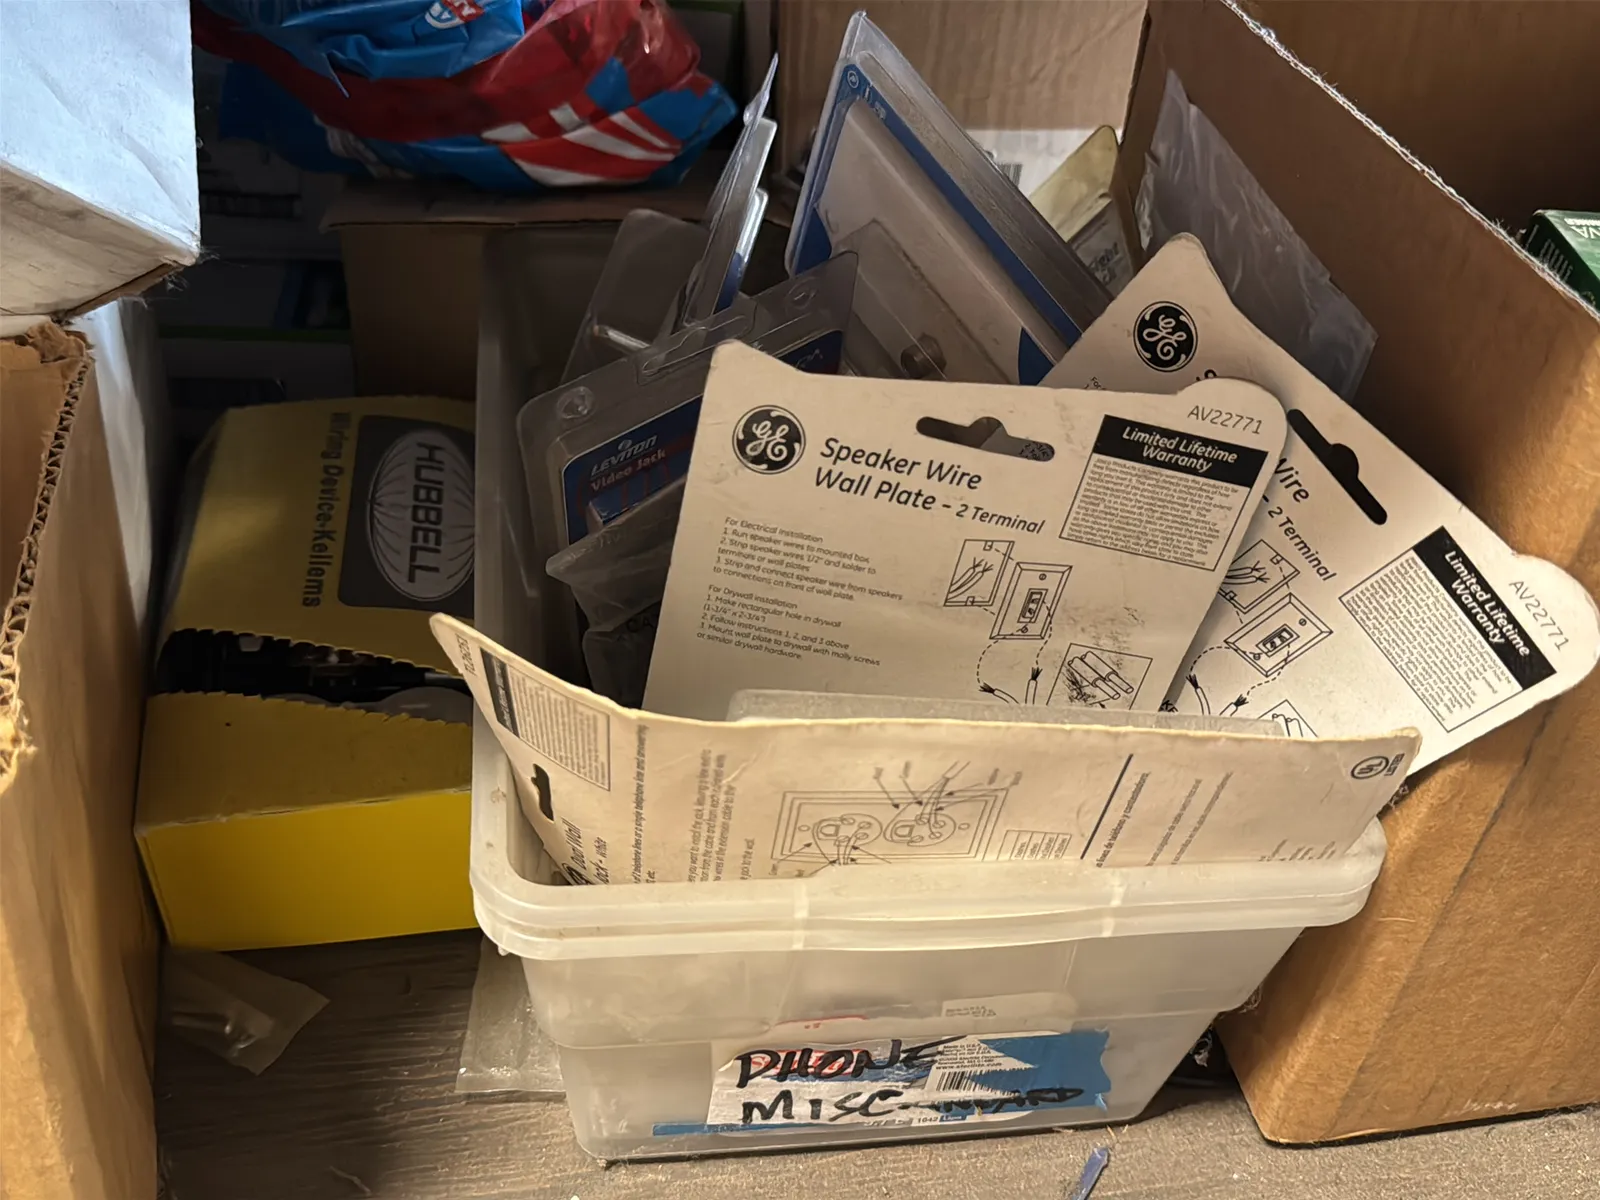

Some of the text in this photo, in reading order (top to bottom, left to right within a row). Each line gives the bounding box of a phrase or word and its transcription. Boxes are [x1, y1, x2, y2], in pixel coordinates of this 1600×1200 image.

[1187, 405, 1262, 434] AV22771
[820, 437, 982, 490] Speaker Wire
[1122, 427, 1238, 464] Limited Lifetime
[1142, 444, 1212, 473] Warranty
[591, 449, 666, 491] Video Jack
[408, 442, 445, 583] HUBBELL
[815, 467, 872, 497] Wall
[875, 481, 936, 510] Plate
[956, 504, 969, 517] 2
[971, 506, 1046, 534] Terminal
[724, 516, 739, 526] For
[815, 545, 852, 559] mounted
[823, 558, 840, 568] and
[1268, 506, 1282, 518] 2
[1278, 517, 1337, 582] Terminal
[707, 584, 722, 594] For
[743, 562, 760, 572] and
[846, 582, 866, 593] from
[866, 586, 903, 601] speakers
[714, 596, 736, 606] Make
[784, 610, 801, 620] hole
[1444, 550, 1530, 657] Limited Lifetime
[1451, 579, 1505, 644] Warranty
[1509, 581, 1569, 650] AV22771
[709, 614, 736, 626] Follow
[799, 633, 817, 643] and
[823, 638, 849, 650] above
[851, 654, 880, 666] screws
[561, 816, 587, 870] Dual Wall
[735, 1034, 968, 1088] PHONE
